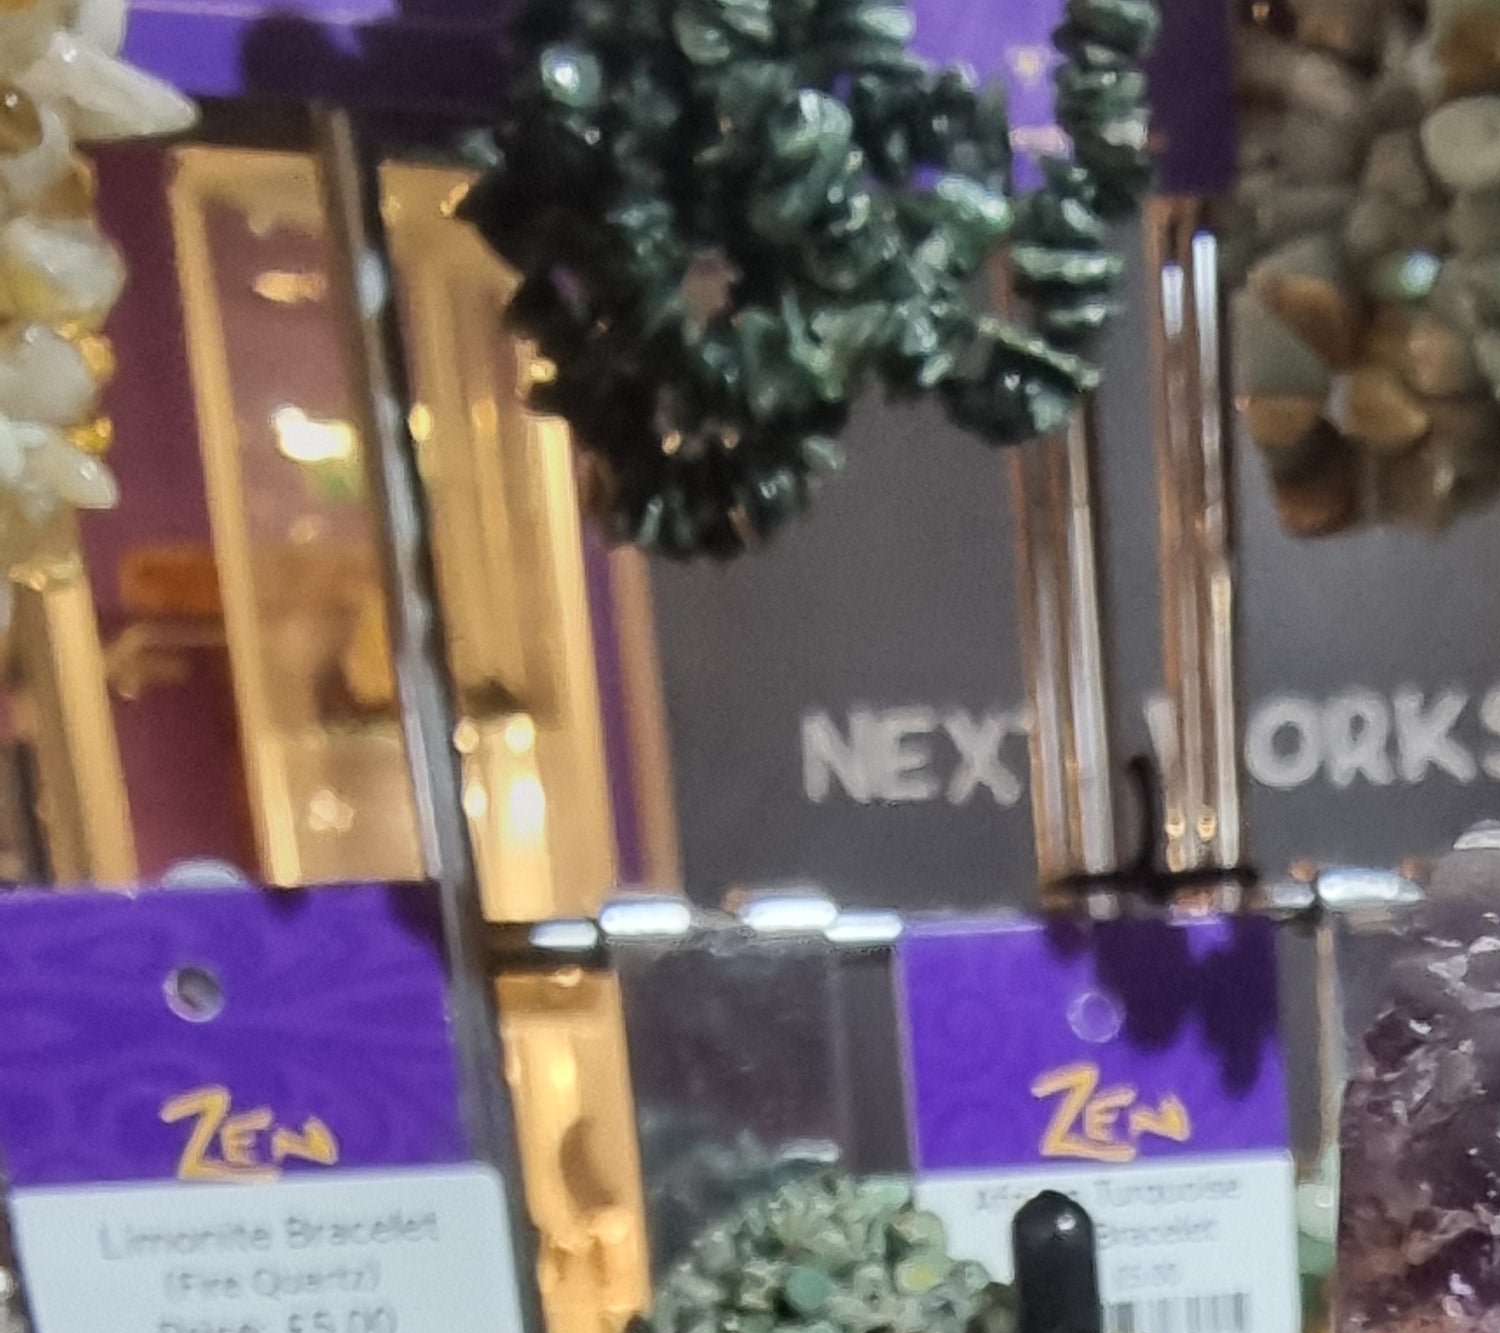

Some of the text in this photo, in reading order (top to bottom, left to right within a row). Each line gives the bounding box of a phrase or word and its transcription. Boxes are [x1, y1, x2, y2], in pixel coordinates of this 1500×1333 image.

[159, 1085, 340, 1182] ZEN
[1032, 1063, 1192, 1162] ZEN
[98, 1210, 440, 1260] Limonite Bracelet
